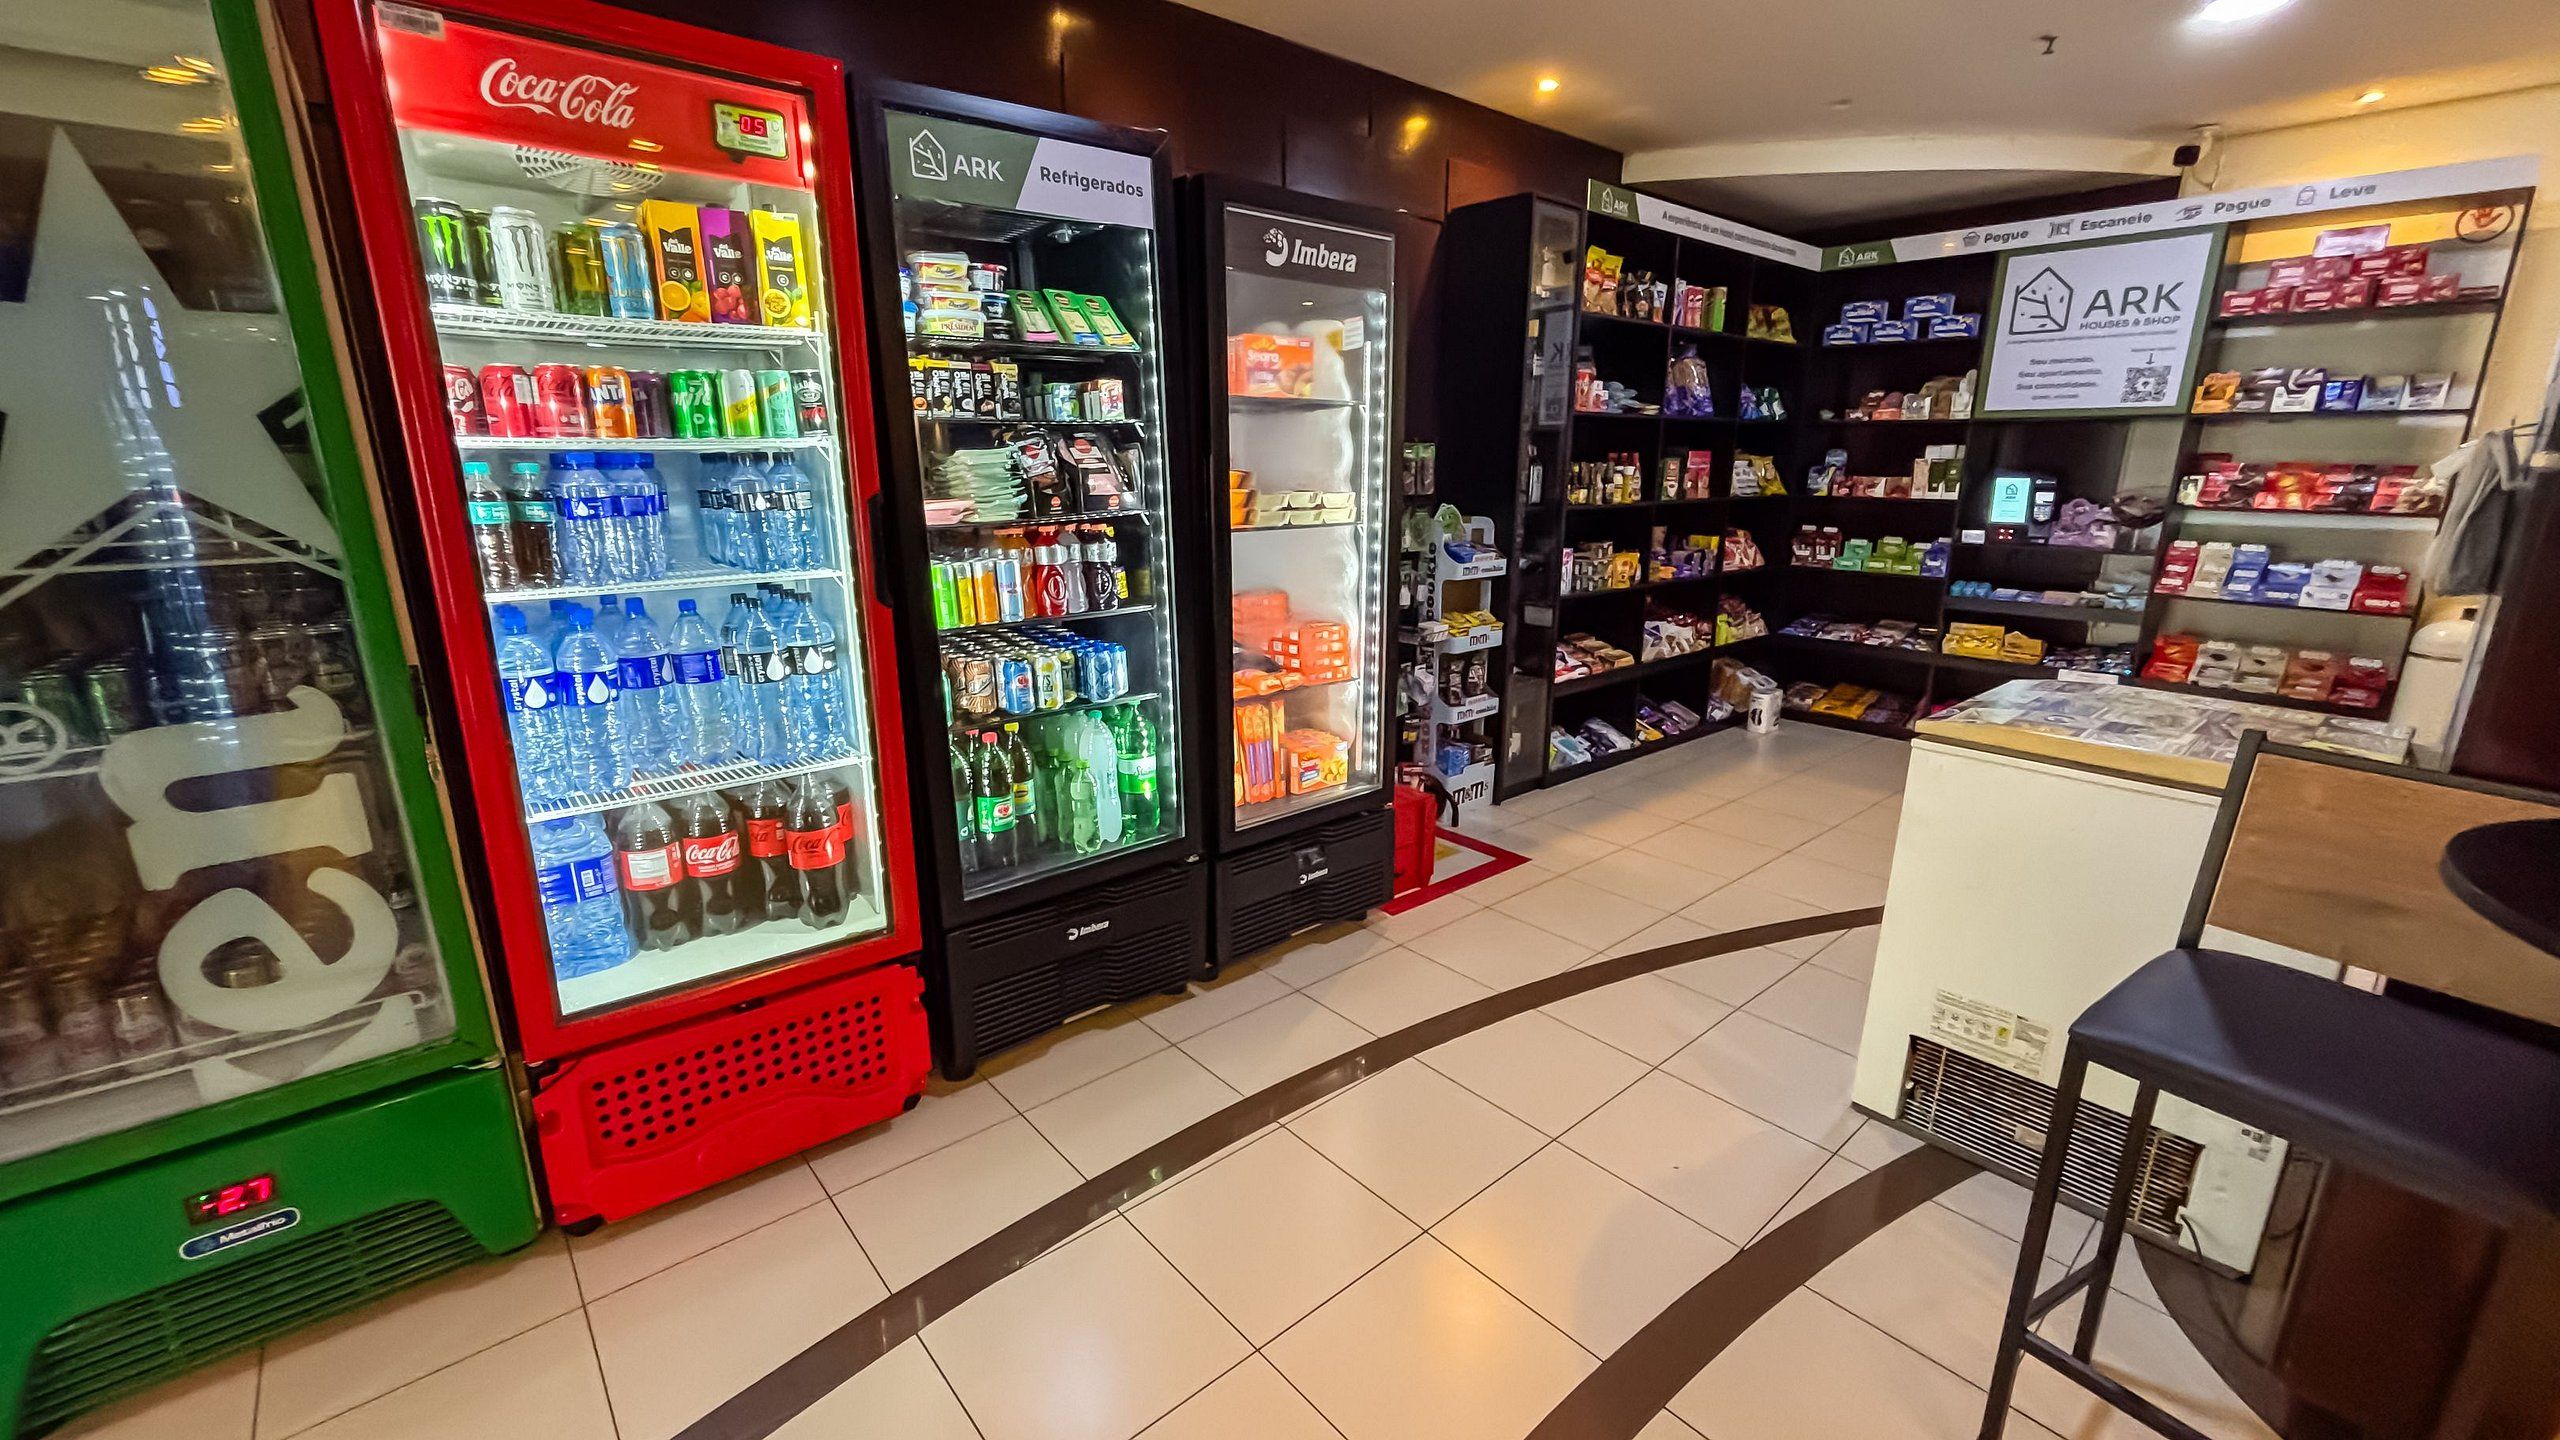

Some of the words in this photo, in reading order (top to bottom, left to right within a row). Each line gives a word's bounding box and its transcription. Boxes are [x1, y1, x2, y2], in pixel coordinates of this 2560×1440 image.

[480, 58, 639, 130] Coca-Cola
[740, 116, 766, 136] 05
[954, 154, 1004, 181] ARK
[1040, 167, 1144, 198] Refrigerados
[2329, 183, 2377, 199] Leve
[2213, 197, 2272, 215] Pague
[663, 241, 693, 254] Valle
[1292, 239, 1358, 273] Imbera
[2082, 281, 2184, 319] ARK
[2079, 319, 2130, 330] HOUSES
[2143, 315, 2181, 326] SHOP
[649, 657, 661, 686] crystal
[508, 679, 523, 712] crystal
[573, 674, 586, 706] crystal
